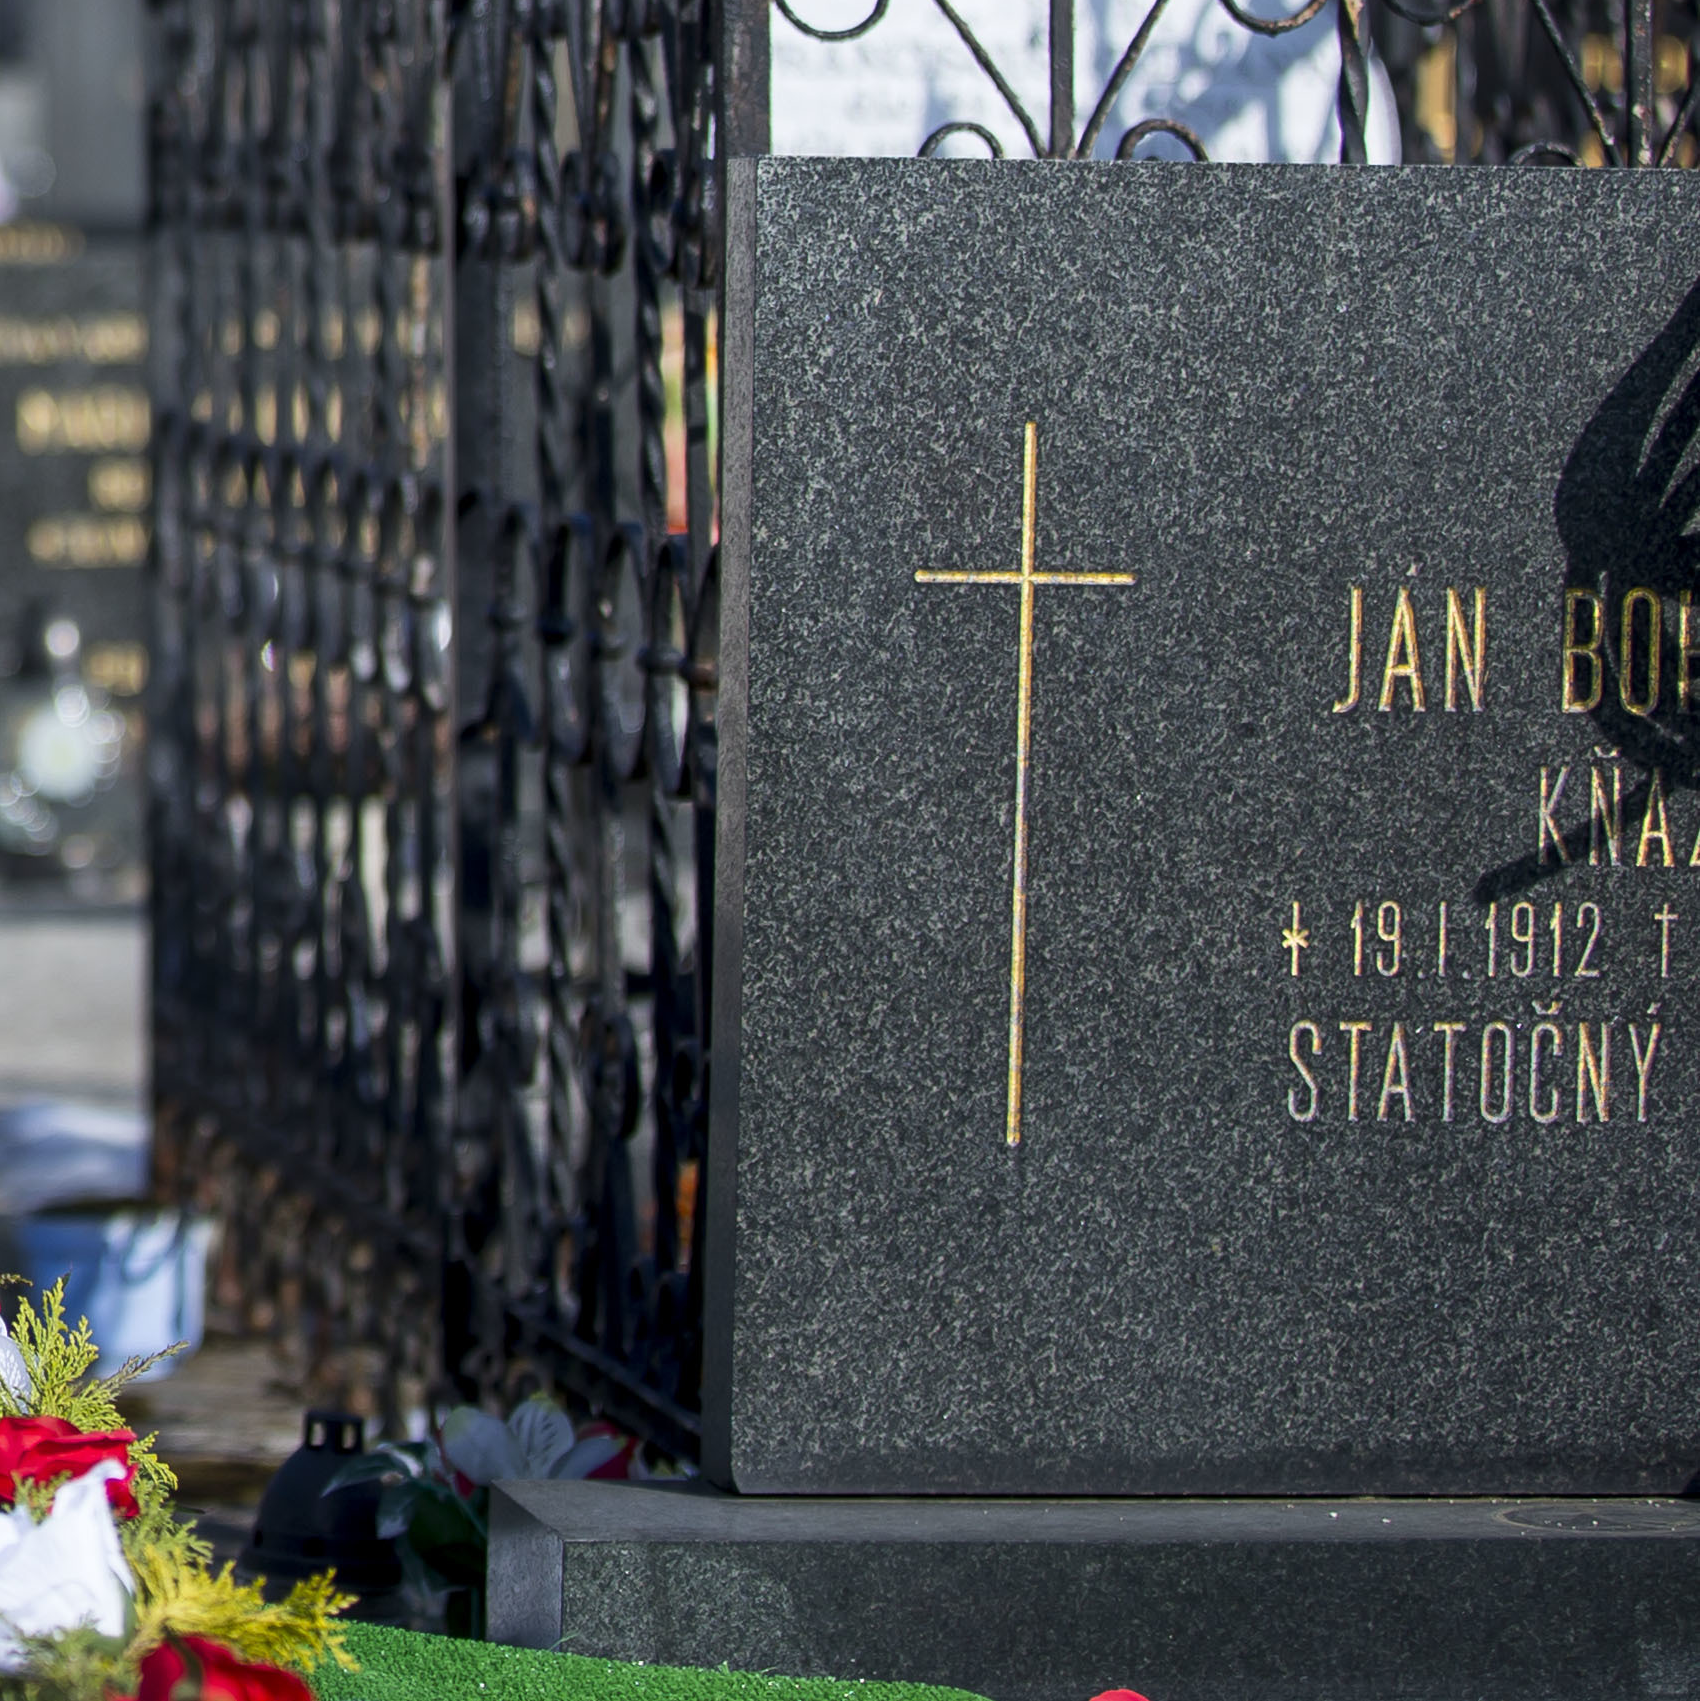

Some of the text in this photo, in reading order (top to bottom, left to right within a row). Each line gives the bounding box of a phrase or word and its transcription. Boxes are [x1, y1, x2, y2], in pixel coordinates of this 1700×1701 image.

[1332, 562, 1487, 713] JÁN
[1538, 745, 1700, 868] KŇA
[1287, 999, 1662, 1124] STATOČNÝ
